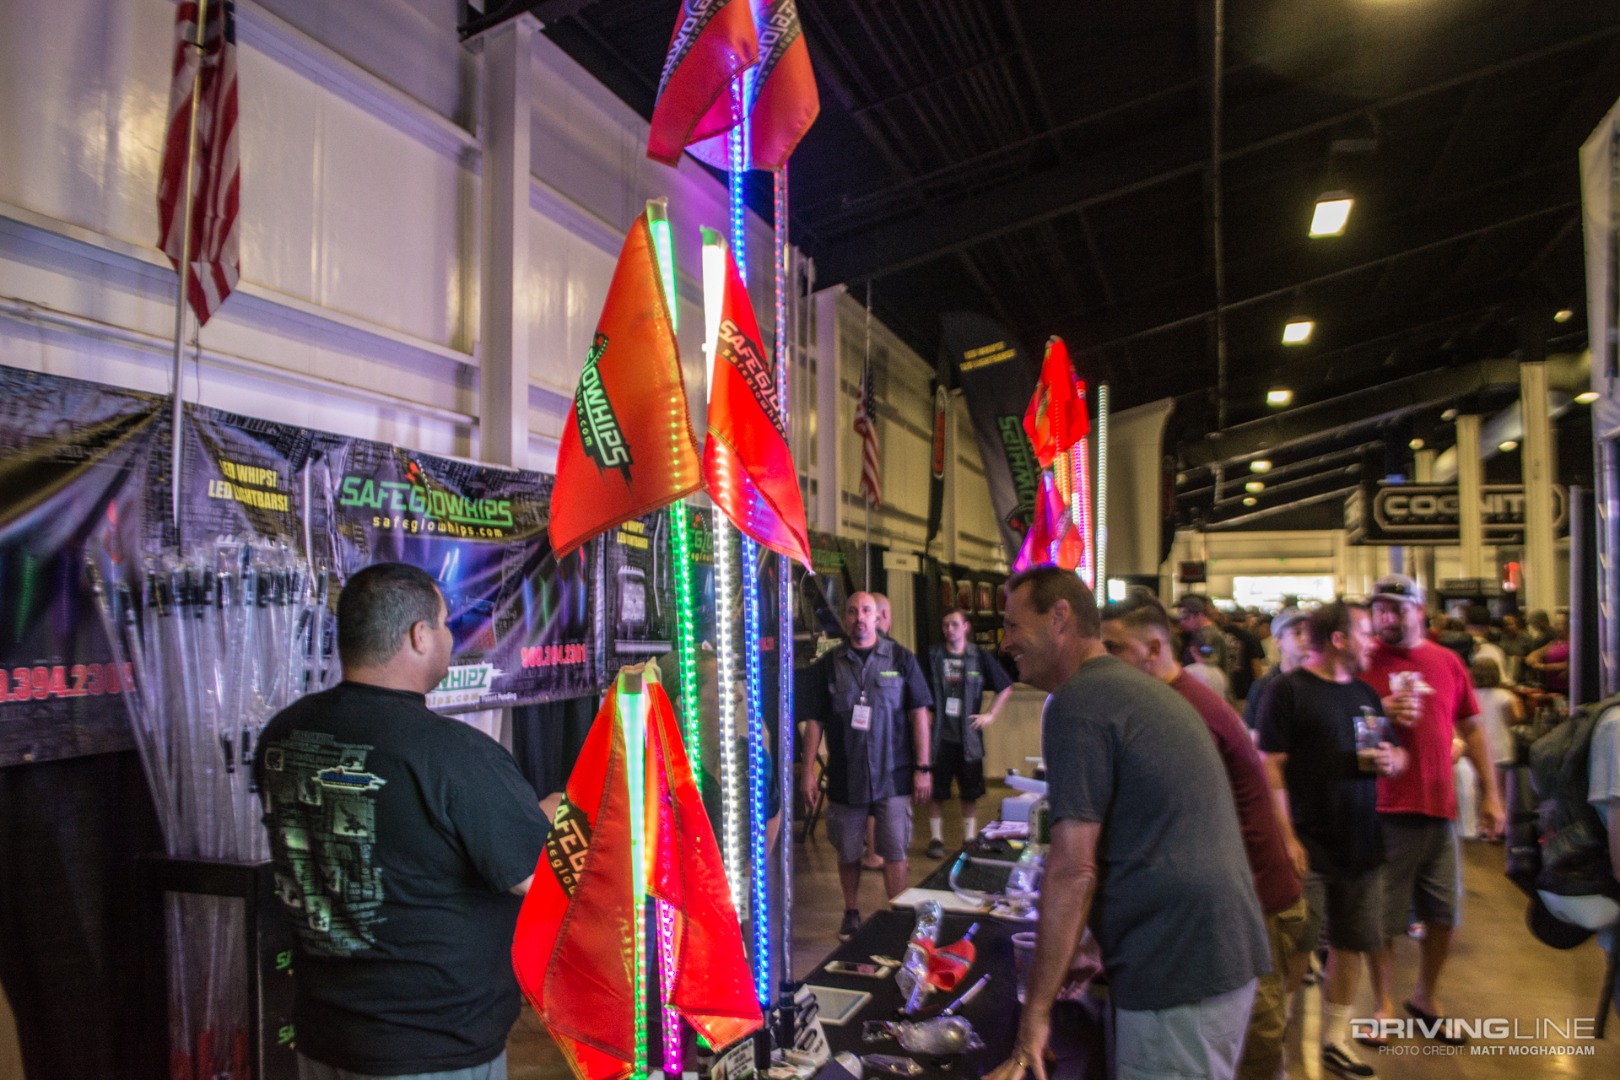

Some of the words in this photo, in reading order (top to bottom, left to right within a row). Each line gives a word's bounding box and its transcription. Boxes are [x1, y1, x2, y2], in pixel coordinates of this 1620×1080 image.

[236, 463, 277, 488] WHIPS!
[208, 479, 233, 500] LED
[340, 476, 513, 527] SAFEGLOWHIPS
[372, 515, 503, 537] safeglowhips.com
